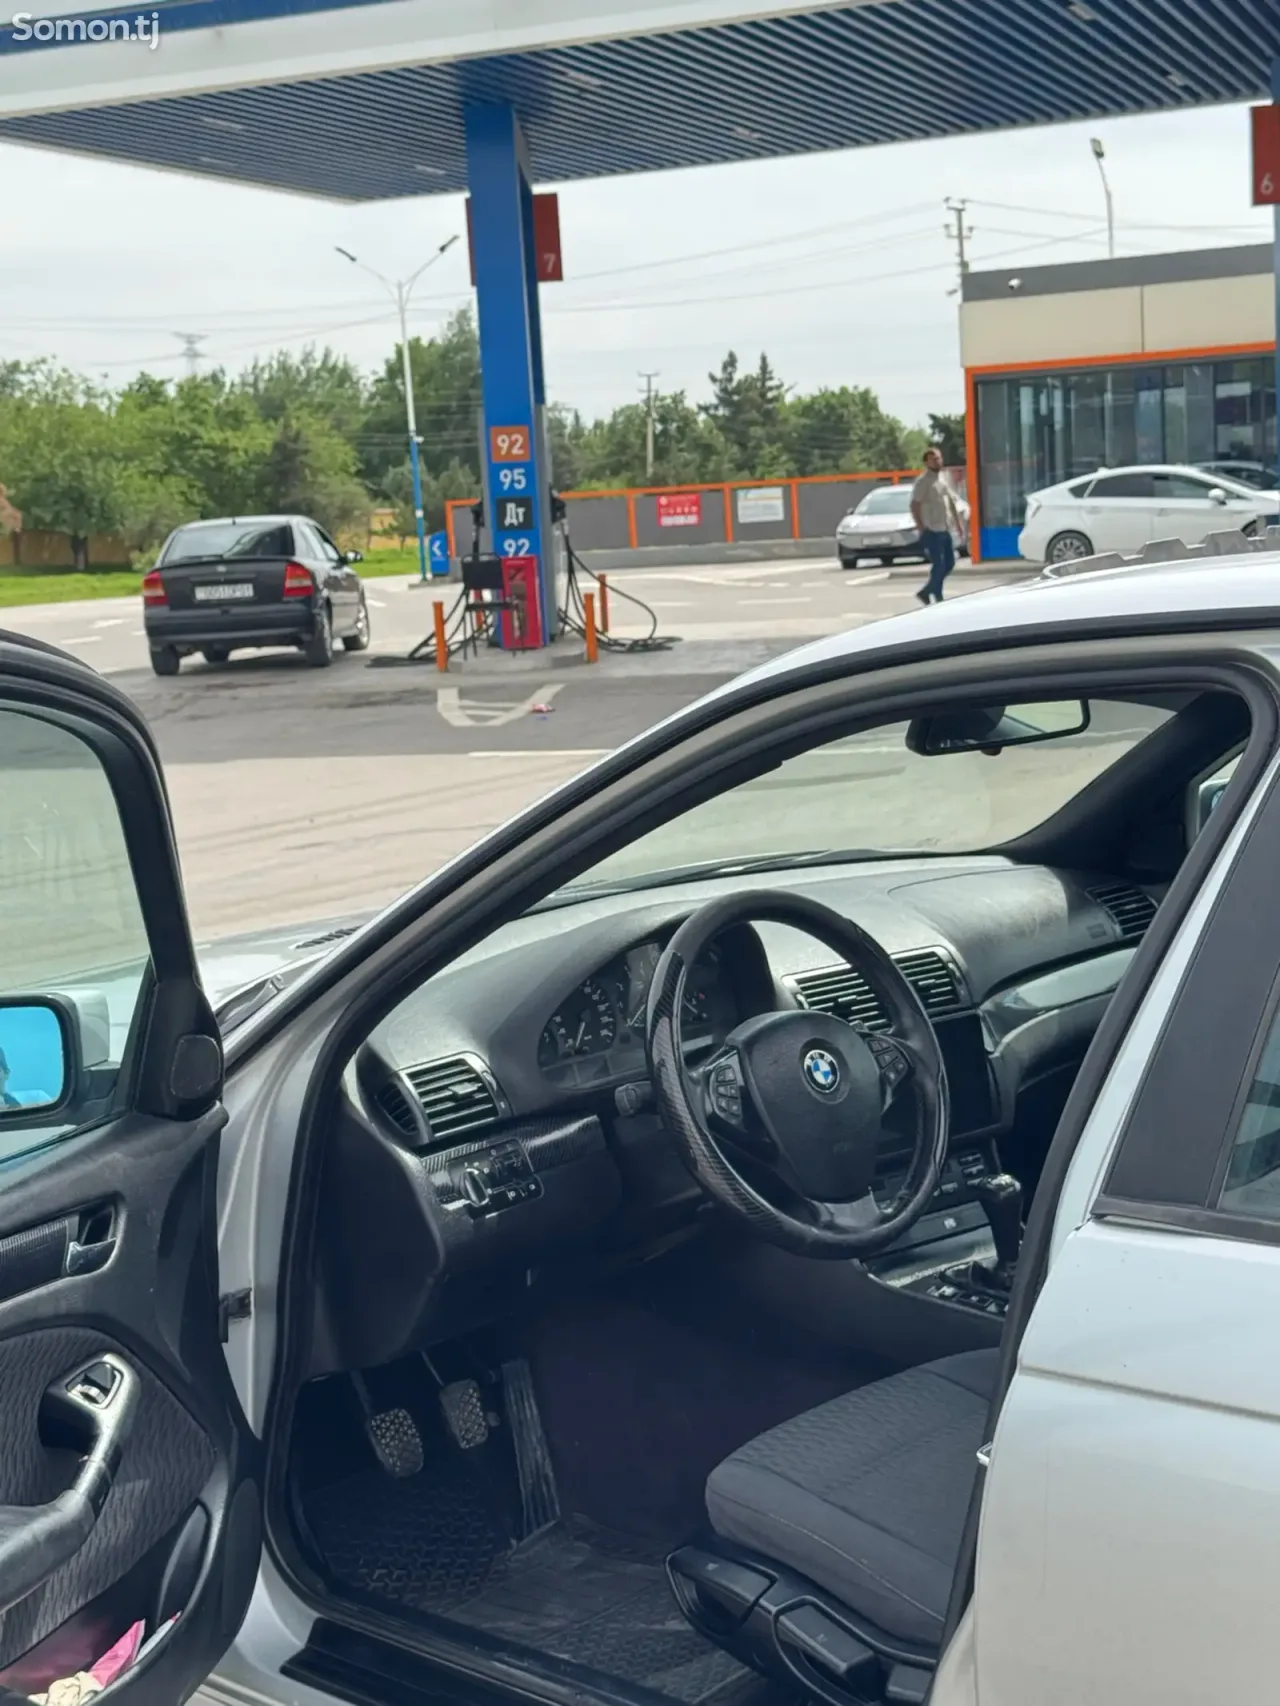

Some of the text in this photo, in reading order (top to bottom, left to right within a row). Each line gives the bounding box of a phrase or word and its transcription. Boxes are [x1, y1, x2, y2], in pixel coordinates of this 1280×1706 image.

[1260, 172, 1274, 196] 6
[543, 253, 556, 273] 7
[497, 433, 525, 455] 92
[499, 468, 527, 491] 95
[504, 502, 526, 526] Дт
[503, 538, 530, 558] 92
